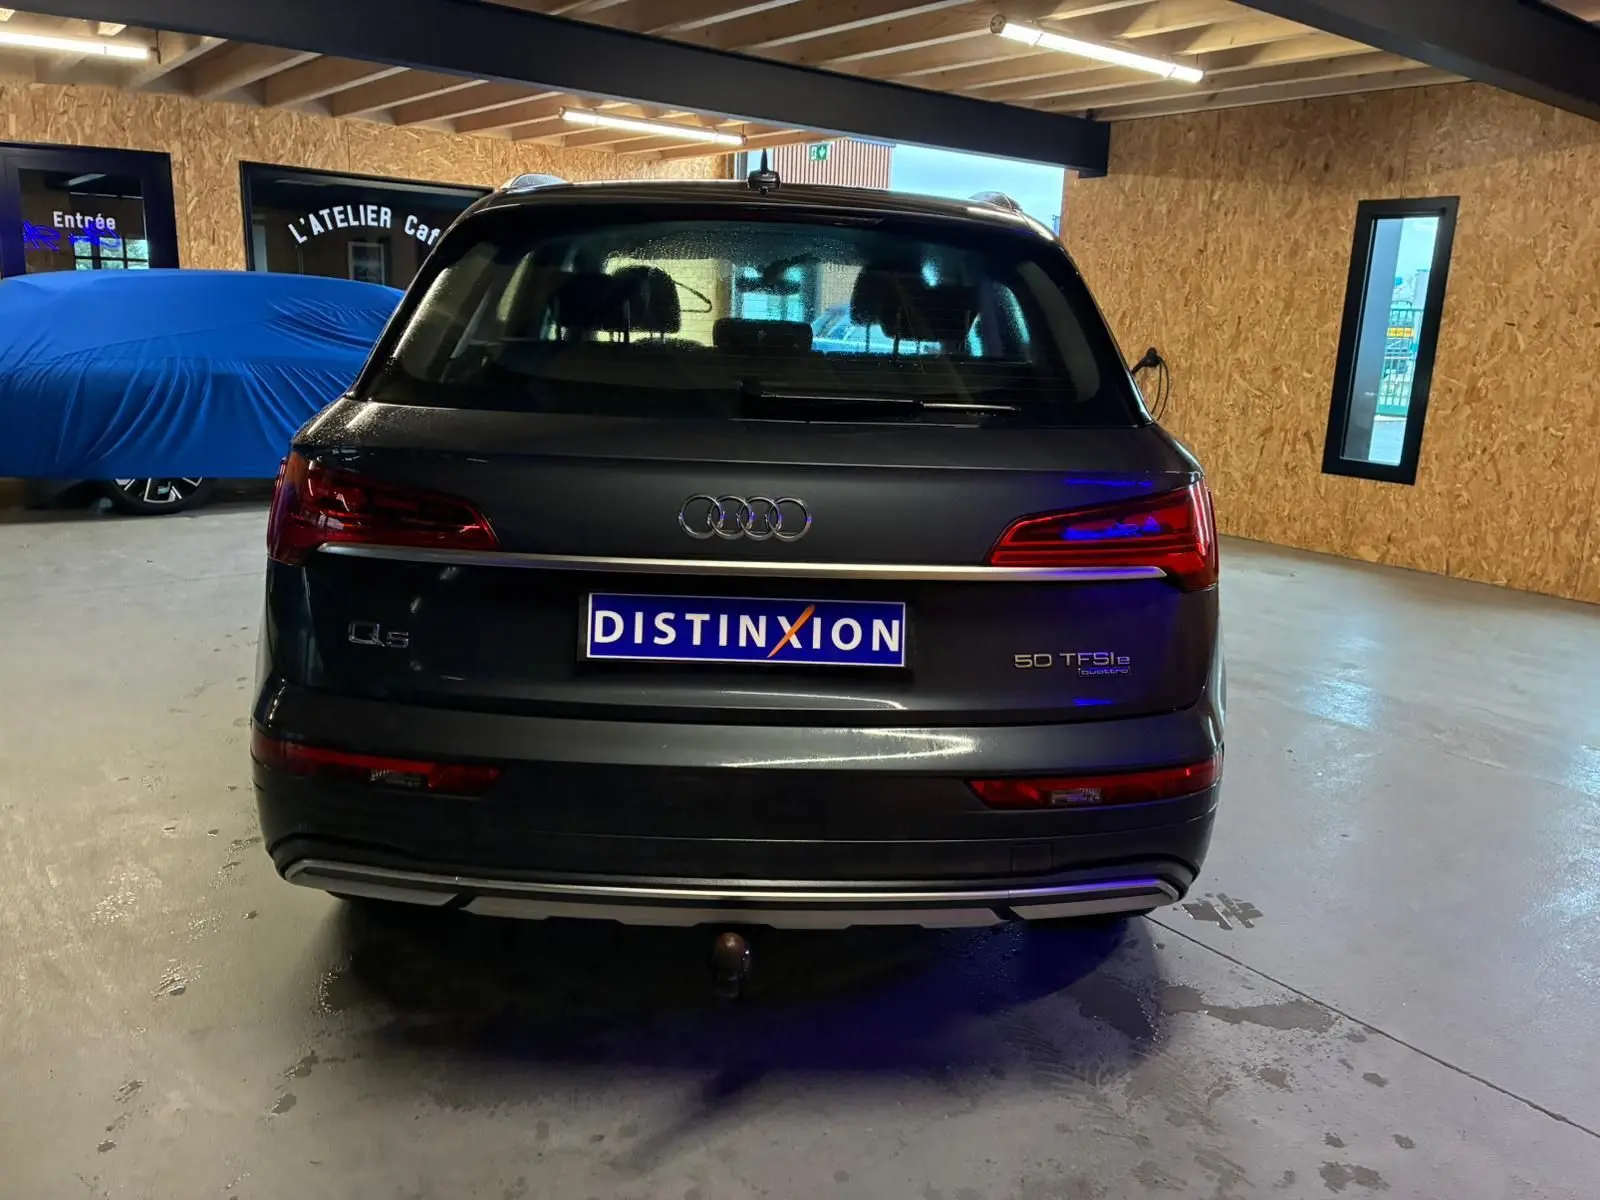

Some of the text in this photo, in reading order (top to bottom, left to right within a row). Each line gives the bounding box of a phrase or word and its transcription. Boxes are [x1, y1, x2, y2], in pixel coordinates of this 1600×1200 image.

[52, 210, 116, 230] Entrée
[288, 204, 441, 246] L'ATELIER Caf
[348, 621, 409, 648] Q5
[593, 603, 900, 658] DISTINXION
[1014, 653, 1052, 668] 50
[1080, 667, 1129, 676] quattro
